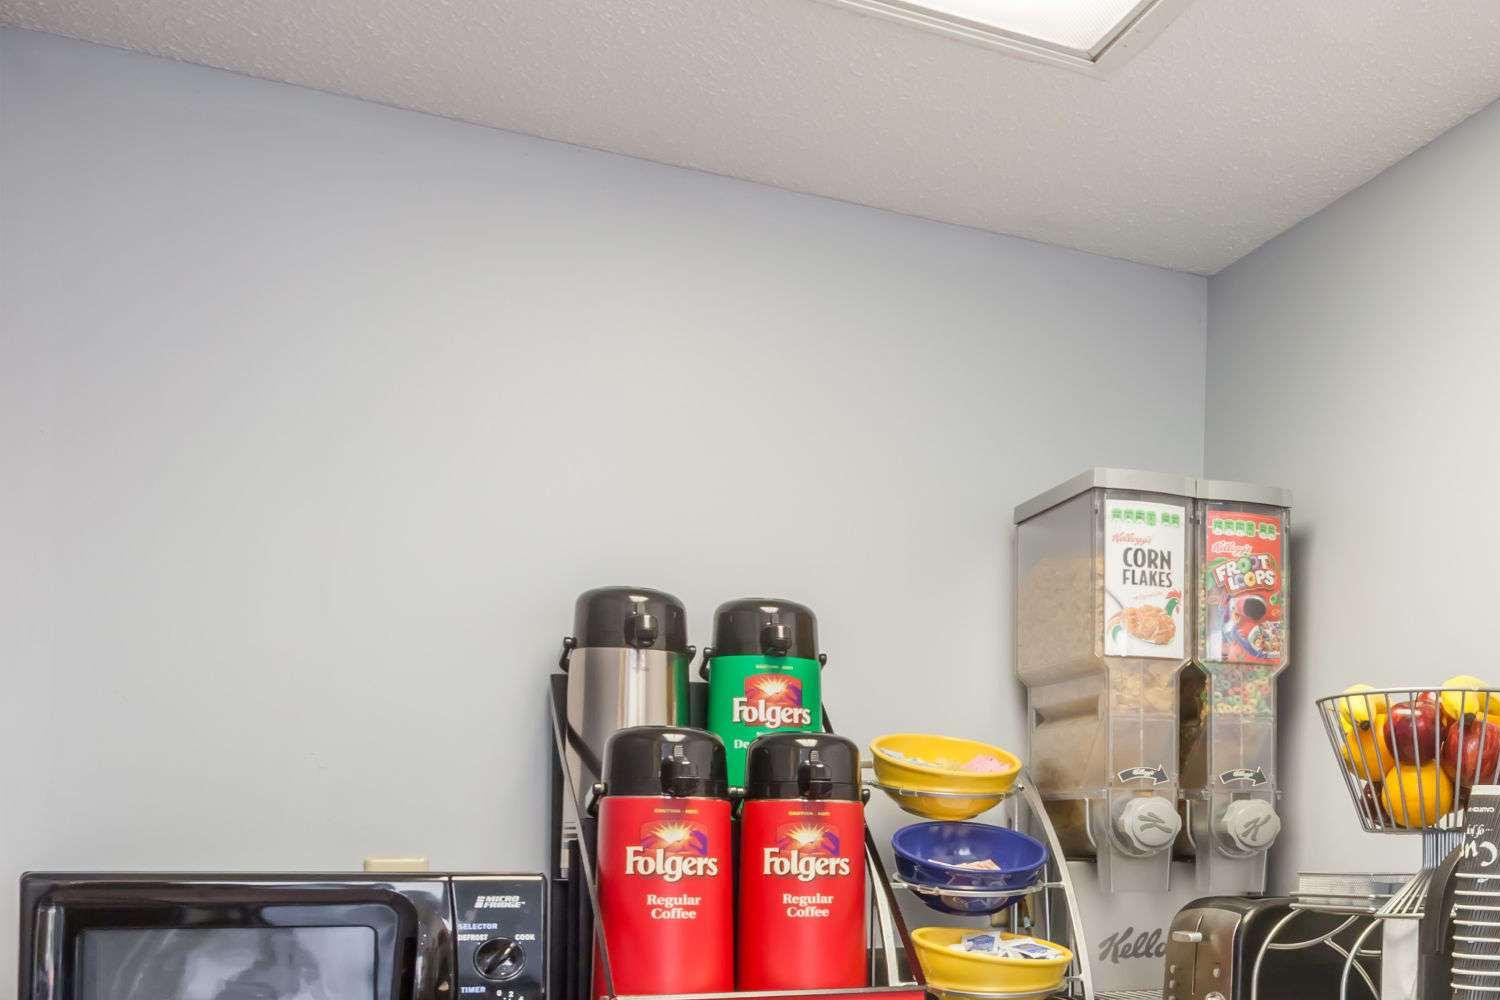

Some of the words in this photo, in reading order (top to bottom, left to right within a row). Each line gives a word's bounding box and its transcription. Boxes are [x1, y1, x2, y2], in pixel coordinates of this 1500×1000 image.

[1122, 547, 1172, 570] CORN
[1122, 569, 1173, 588] FLAKES
[732, 697, 812, 729] Folgers
[1240, 813, 1272, 842] K
[625, 846, 719, 882] Folgers
[762, 847, 851, 882] Folgers
[646, 894, 702, 908] Regular
[782, 893, 834, 907] Regular
[651, 907, 697, 919] Coffee
[786, 906, 830, 918] Coffee
[514, 933, 536, 941] COOK
[460, 986, 487, 994] TIMER
[508, 990, 514, 998] 2
